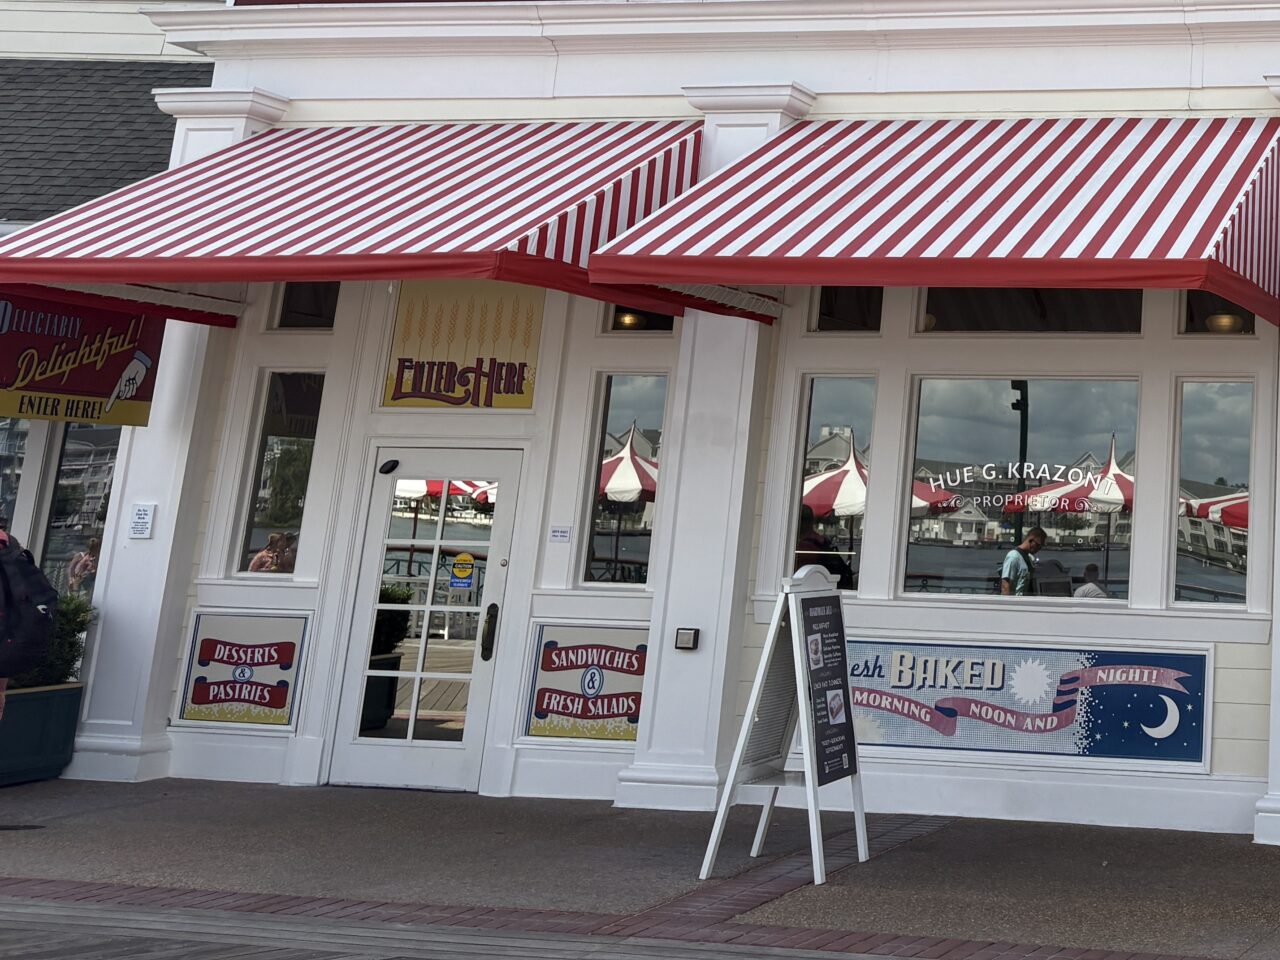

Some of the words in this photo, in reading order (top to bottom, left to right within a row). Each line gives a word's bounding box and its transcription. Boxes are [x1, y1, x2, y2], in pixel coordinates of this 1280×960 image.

[7, 314, 145, 390] Delightful!
[391, 358, 471, 406] ENTER
[457, 357, 528, 408] HERE
[18, 394, 61, 417] ENTER
[64, 400, 104, 420] HERE!
[929, 466, 974, 493] HUE
[982, 463, 1002, 480] G.
[1008, 462, 1117, 496] KRAZONT
[973, 493, 1070, 511] PROPRIETOR
[214, 643, 279, 664] DESSERTS
[551, 648, 640, 671] SANDWICHES
[238, 668, 248, 679] &
[587, 671, 598, 690] &
[850, 654, 885, 678] esh
[890, 649, 1005, 691] BAKED
[209, 683, 271, 703] PASTRIES
[542, 692, 583, 715] FRESH
[587, 695, 636, 716] SALADS
[854, 690, 931, 723] MORNING
[969, 702, 1017, 728] NOON
[1022, 715, 1059, 731] AND
[1096, 667, 1158, 684] NIGHT!
